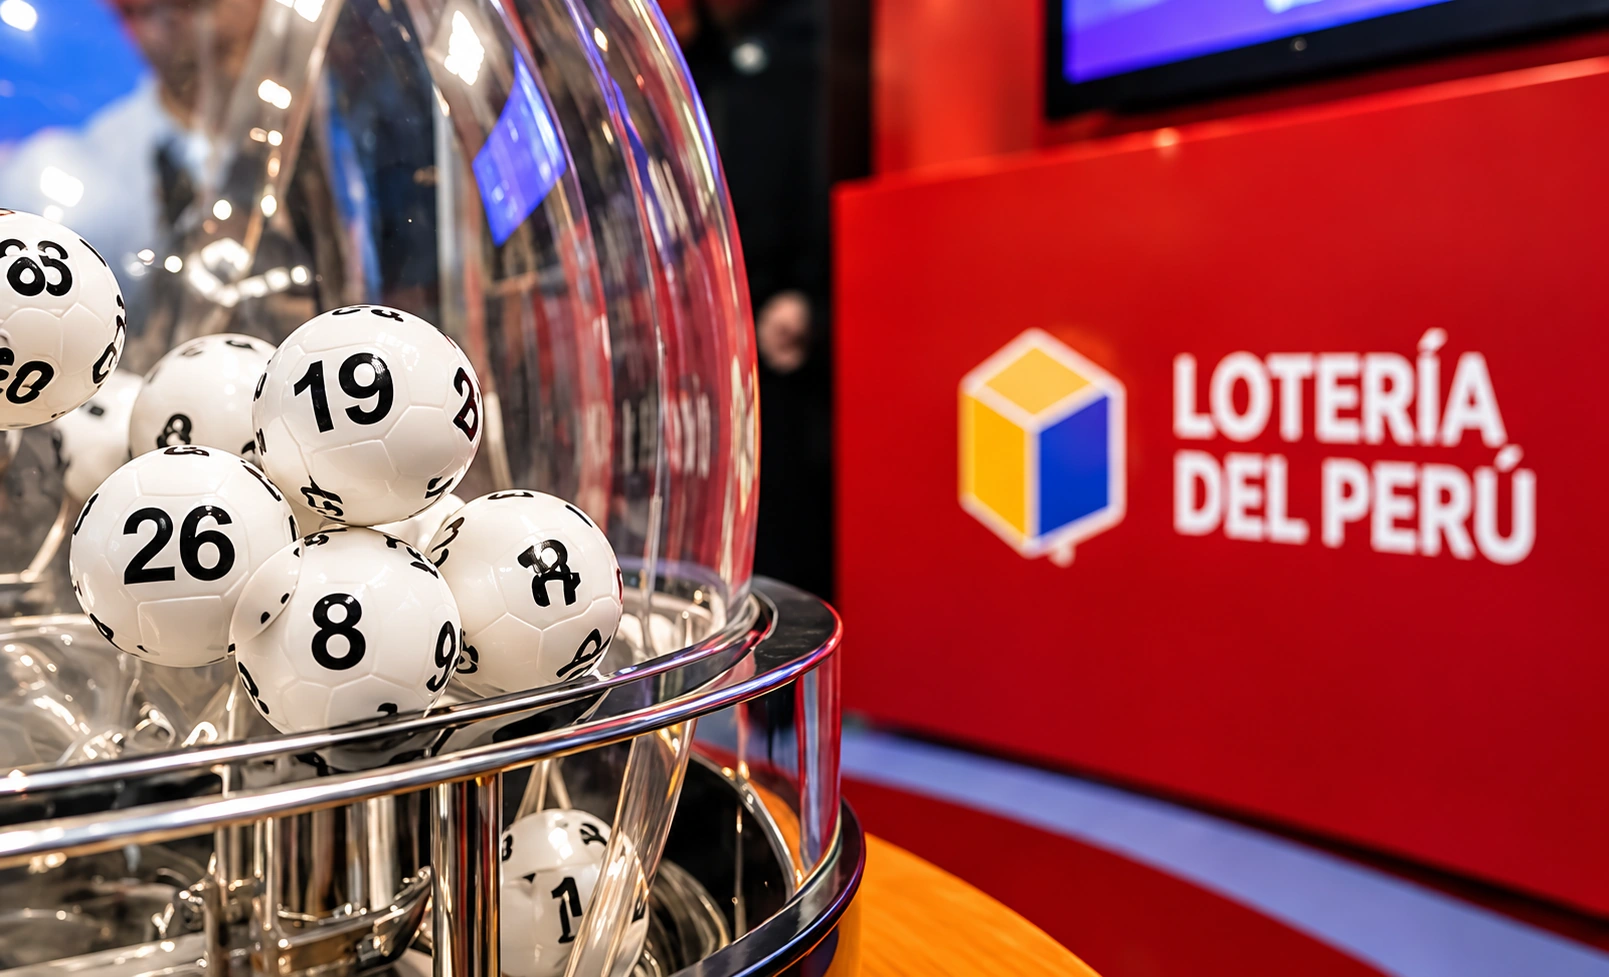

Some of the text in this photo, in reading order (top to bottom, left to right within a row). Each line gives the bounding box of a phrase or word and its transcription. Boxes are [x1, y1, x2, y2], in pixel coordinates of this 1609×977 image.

[293, 352, 395, 433] 19
[1173, 327, 1507, 447] LOTERÍA
[1174, 443, 1537, 565] DEL PERÚ
[122, 505, 236, 585] 26
[311, 592, 367, 671] 8
